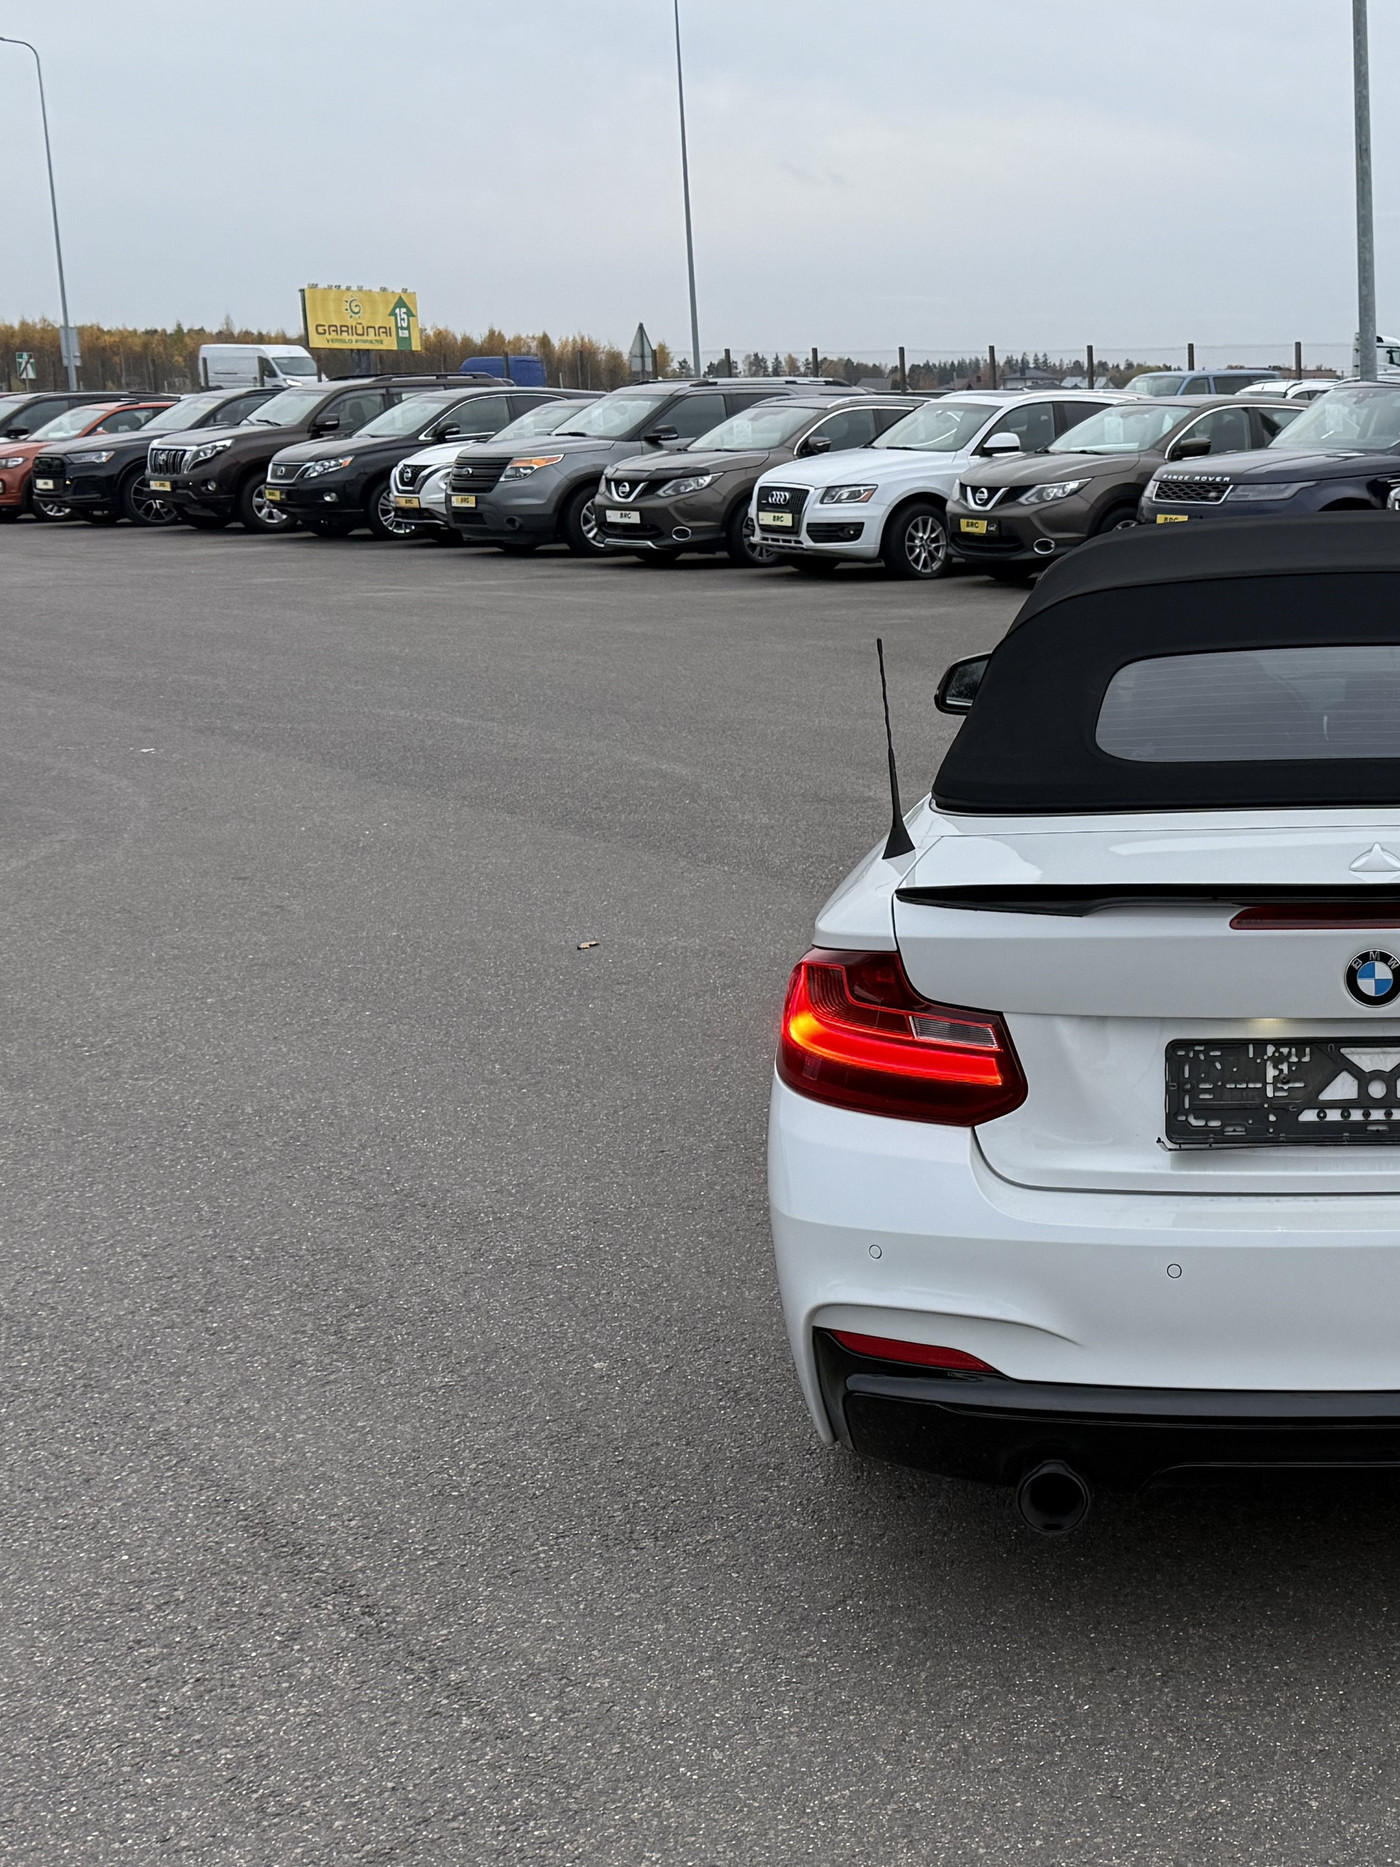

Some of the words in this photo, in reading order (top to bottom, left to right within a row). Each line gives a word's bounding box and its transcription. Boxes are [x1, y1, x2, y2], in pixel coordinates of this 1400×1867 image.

[395, 307, 408, 328] 15
[315, 322, 392, 337] GARIŪNAI
[1351, 951, 1400, 970] BMW
